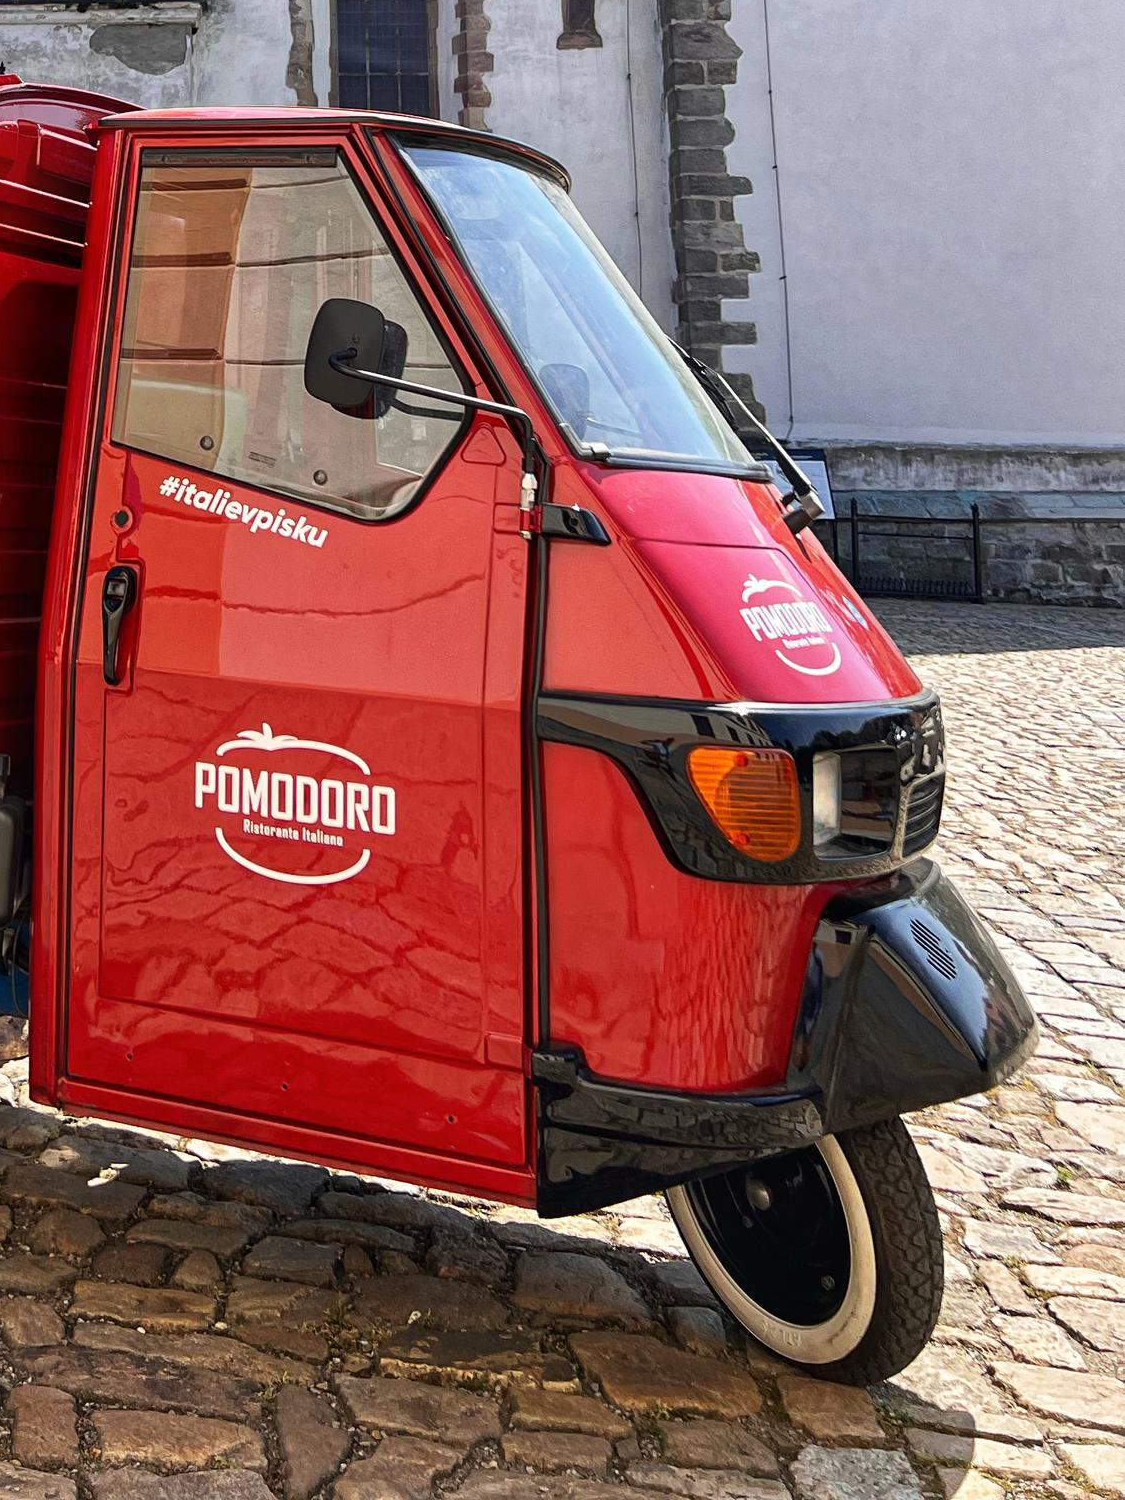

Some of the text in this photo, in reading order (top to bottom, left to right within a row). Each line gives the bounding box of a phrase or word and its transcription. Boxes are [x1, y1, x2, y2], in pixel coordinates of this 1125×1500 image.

[159, 475, 329, 548] #italievpisku
[739, 601, 833, 642] POMODORO
[194, 761, 396, 835] POMODORO
[243, 818, 300, 841] Ristorante
